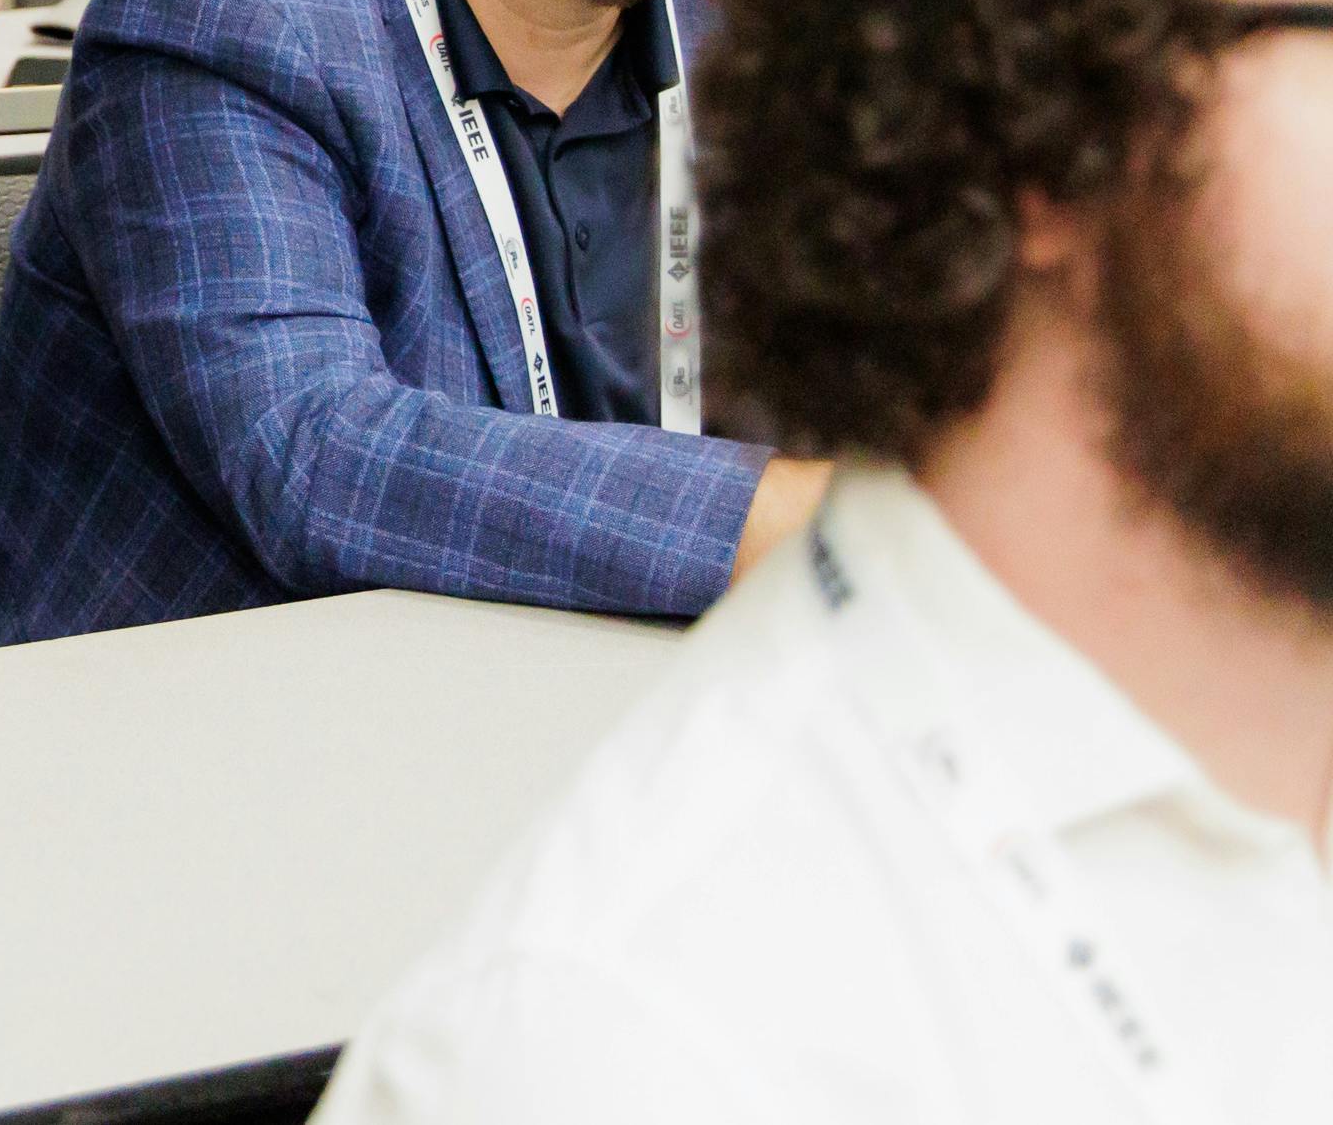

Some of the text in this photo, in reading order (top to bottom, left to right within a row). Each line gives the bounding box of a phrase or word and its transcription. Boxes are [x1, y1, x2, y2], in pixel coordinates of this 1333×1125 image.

[458, 108, 490, 163] IEEE
[669, 205, 689, 259] IEEE
[536, 376, 552, 416] IEE
